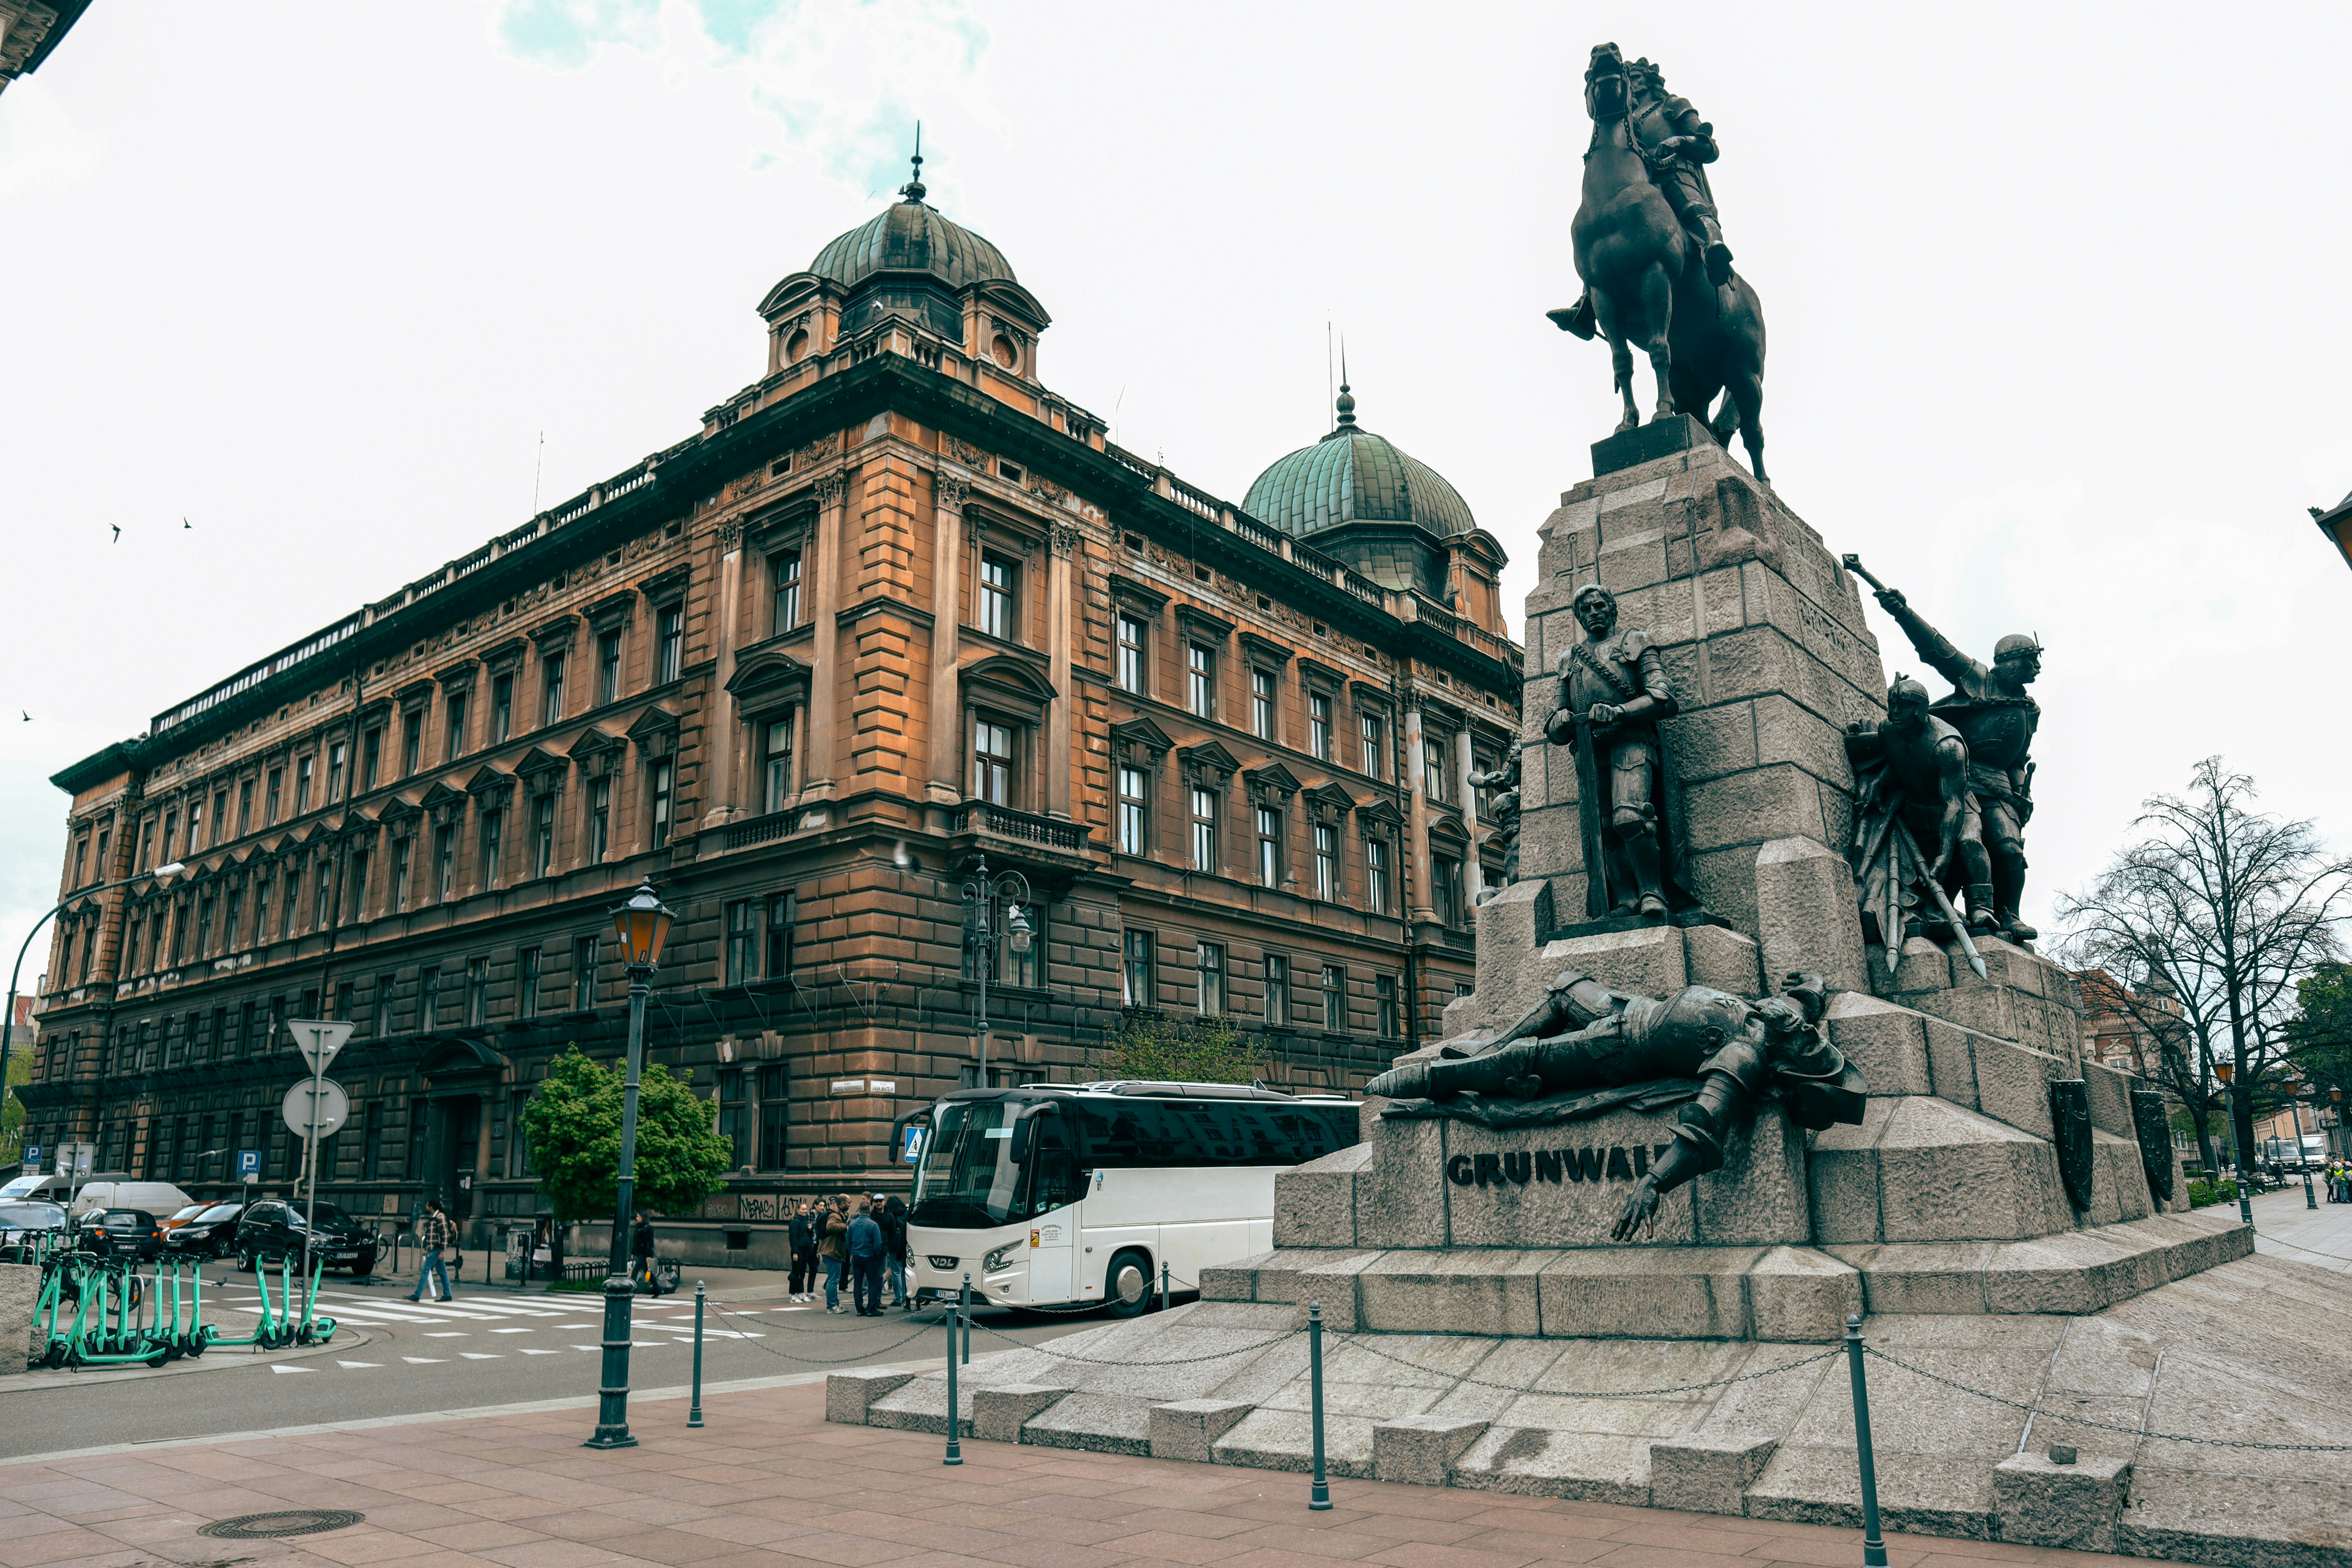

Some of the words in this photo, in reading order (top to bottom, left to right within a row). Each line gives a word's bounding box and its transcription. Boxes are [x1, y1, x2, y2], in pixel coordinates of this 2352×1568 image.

[28, 1147, 38, 1159] P
[243, 1153, 256, 1170] P
[931, 1258, 953, 1267] VDL
